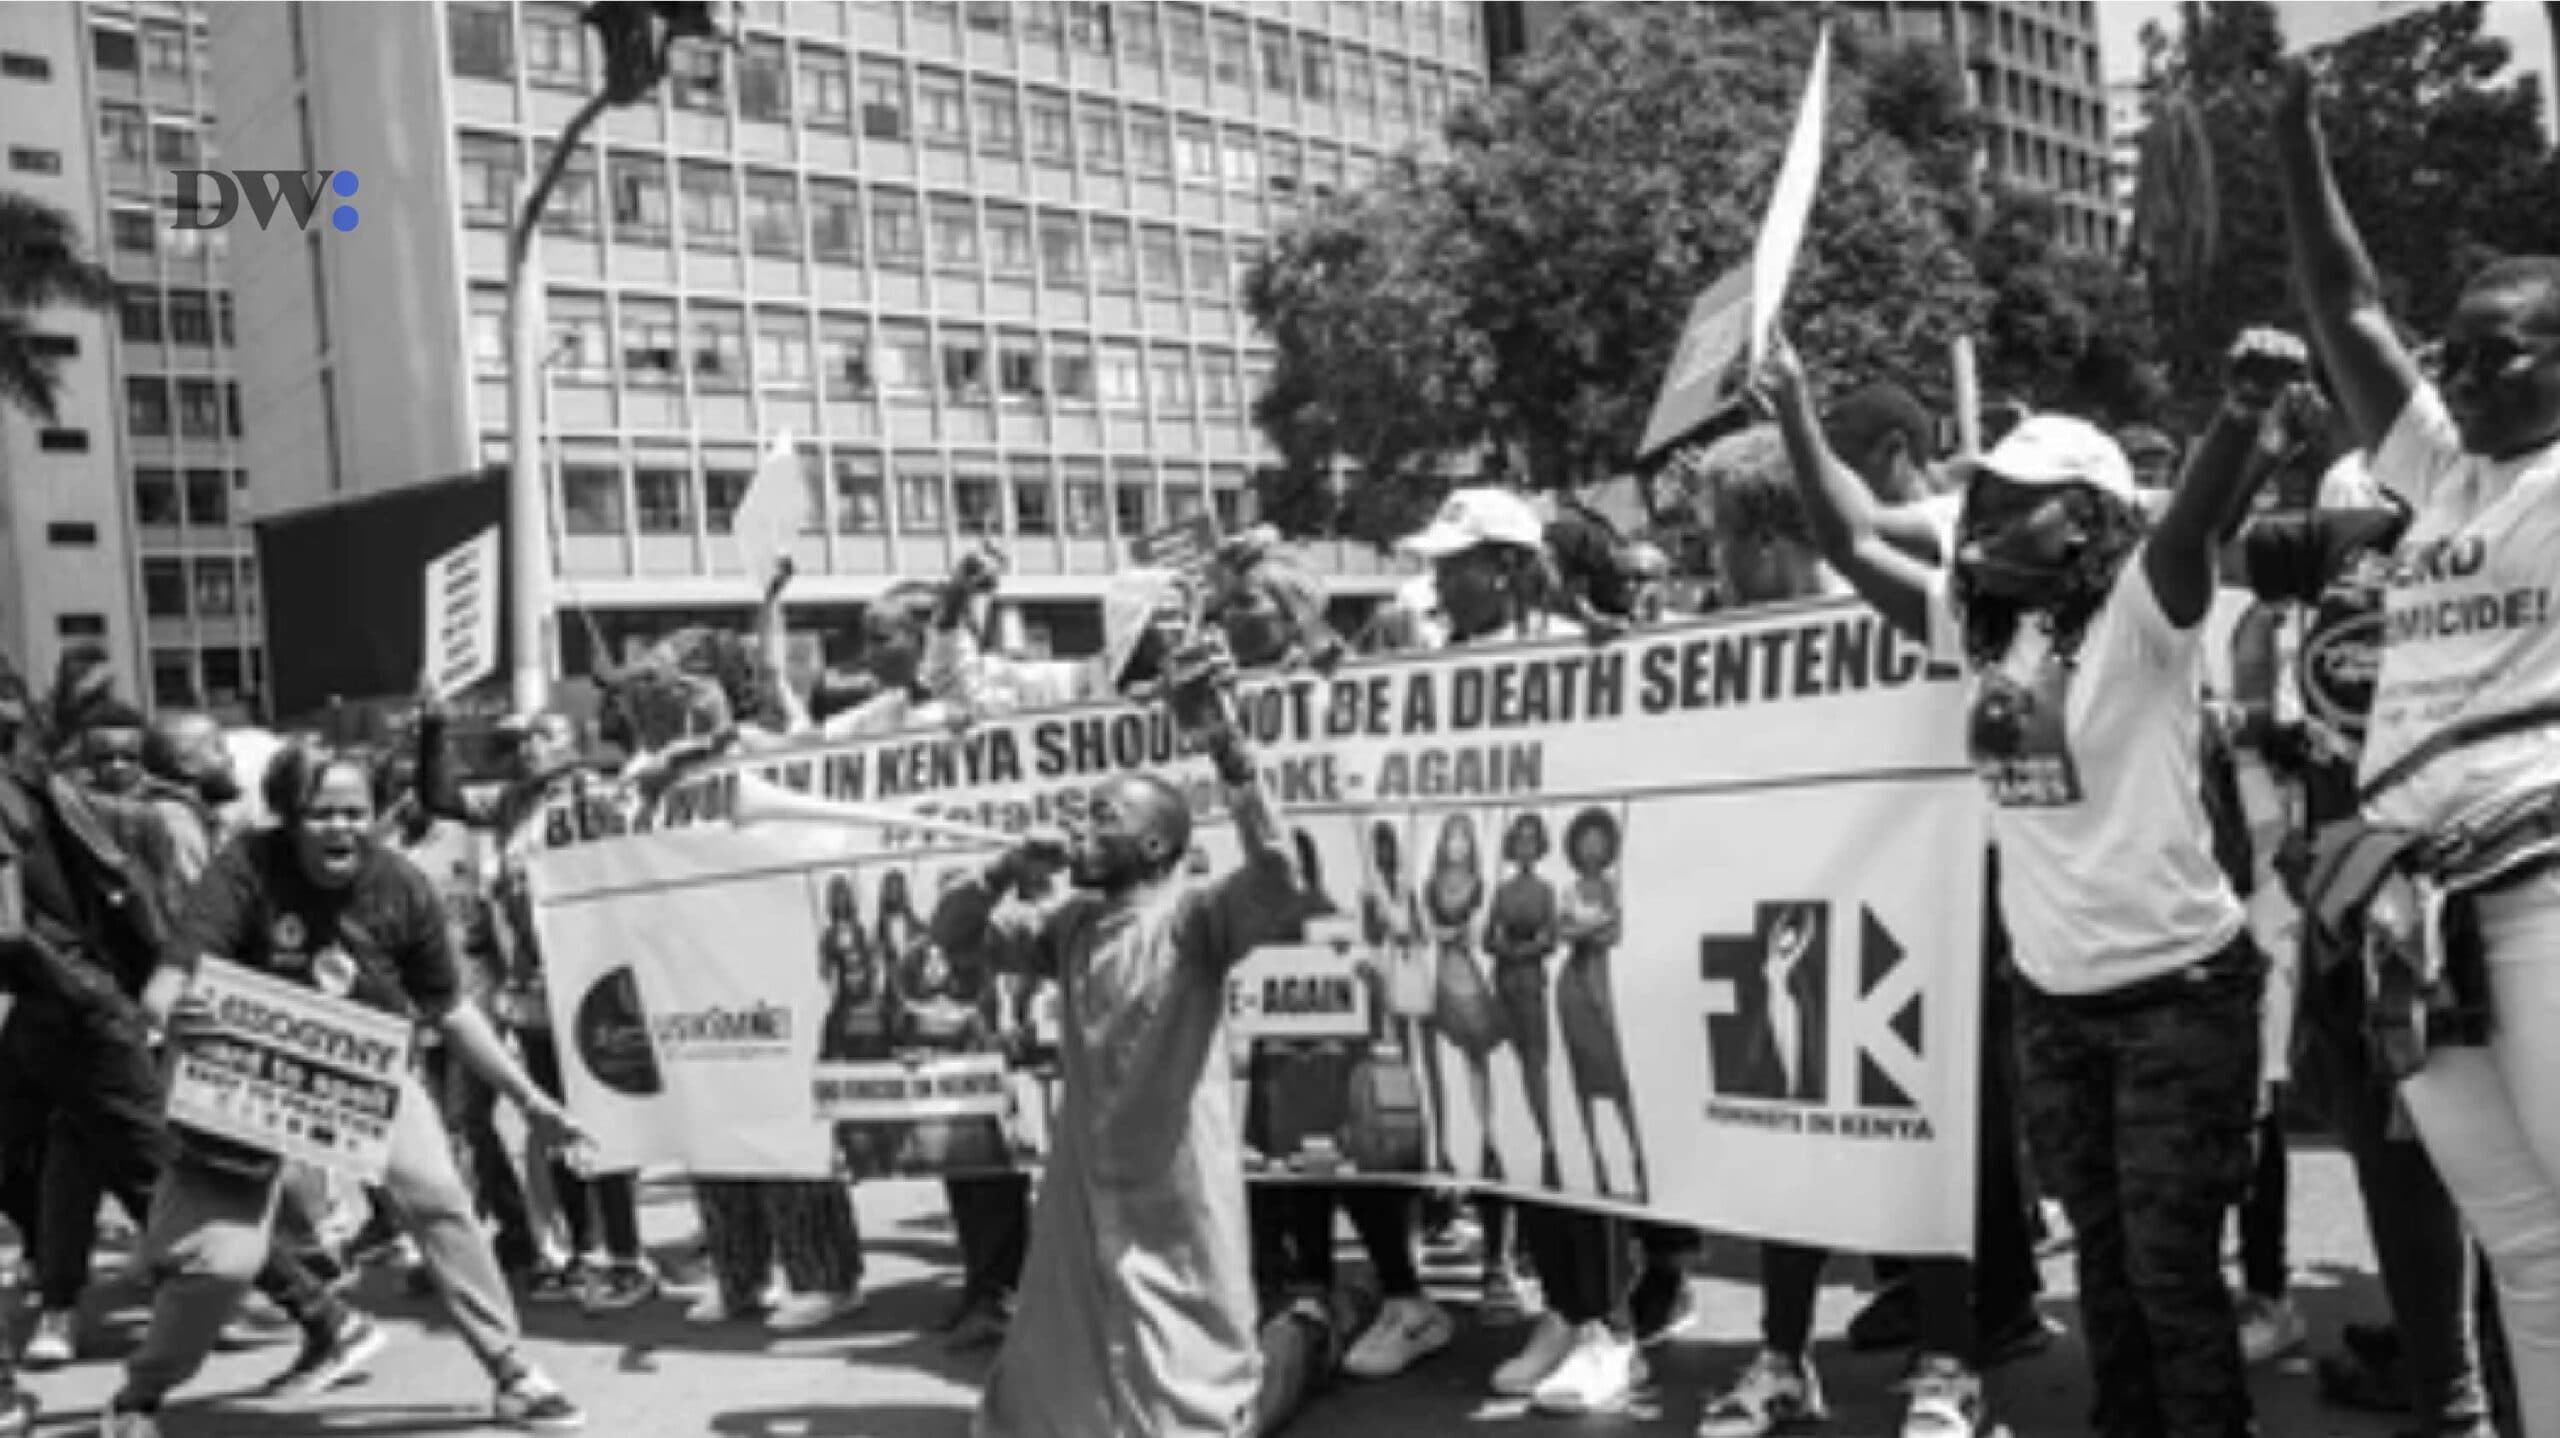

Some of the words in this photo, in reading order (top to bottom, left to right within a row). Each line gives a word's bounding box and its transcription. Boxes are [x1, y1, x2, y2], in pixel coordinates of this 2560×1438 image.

[877, 727, 1022, 798] KENYA
[1035, 708, 1195, 777] SHOU
[1326, 677, 1391, 736] BE
[1402, 671, 1438, 734] A
[1451, 651, 1623, 728] DEATH
[1640, 616, 1960, 716] SENTENC
[1376, 742, 1543, 796] AGAIN
